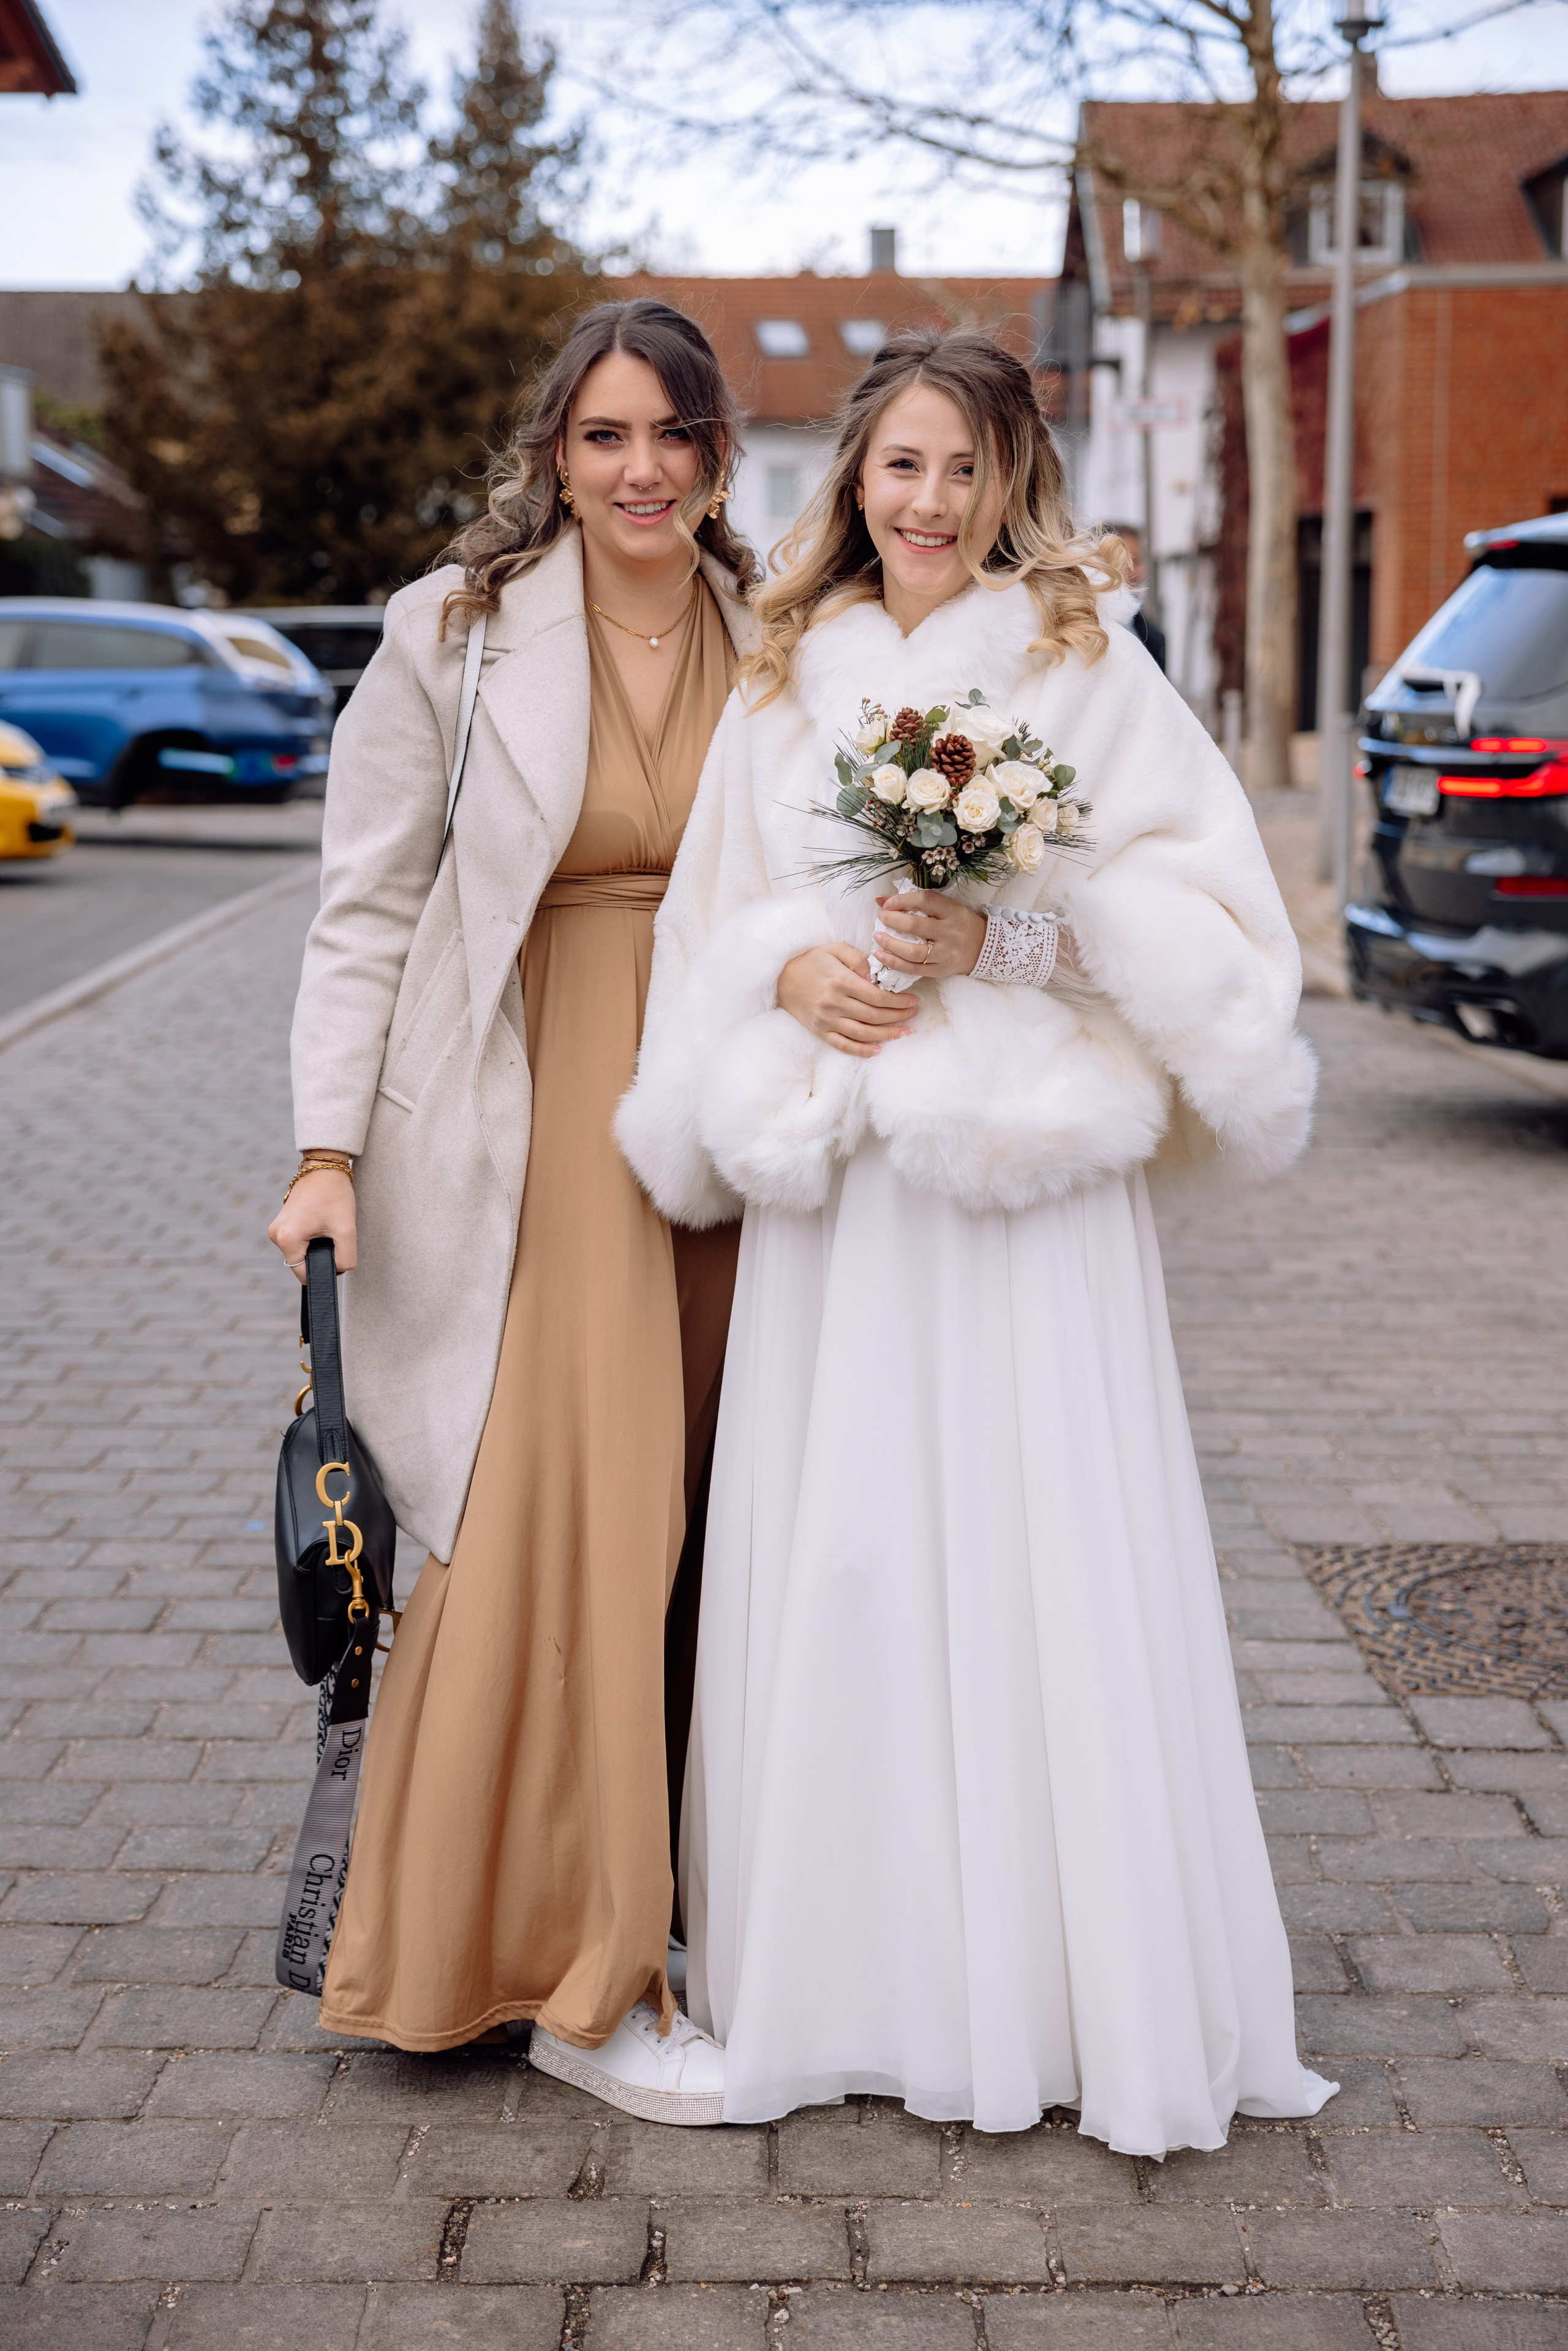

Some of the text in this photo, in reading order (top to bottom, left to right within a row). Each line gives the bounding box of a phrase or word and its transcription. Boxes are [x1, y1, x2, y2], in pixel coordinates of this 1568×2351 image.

[331, 1726, 362, 1781] Dior
[289, 1854, 335, 1965] Christian
[282, 1912, 298, 1959] PARIS
[288, 1969, 312, 1993] Di
